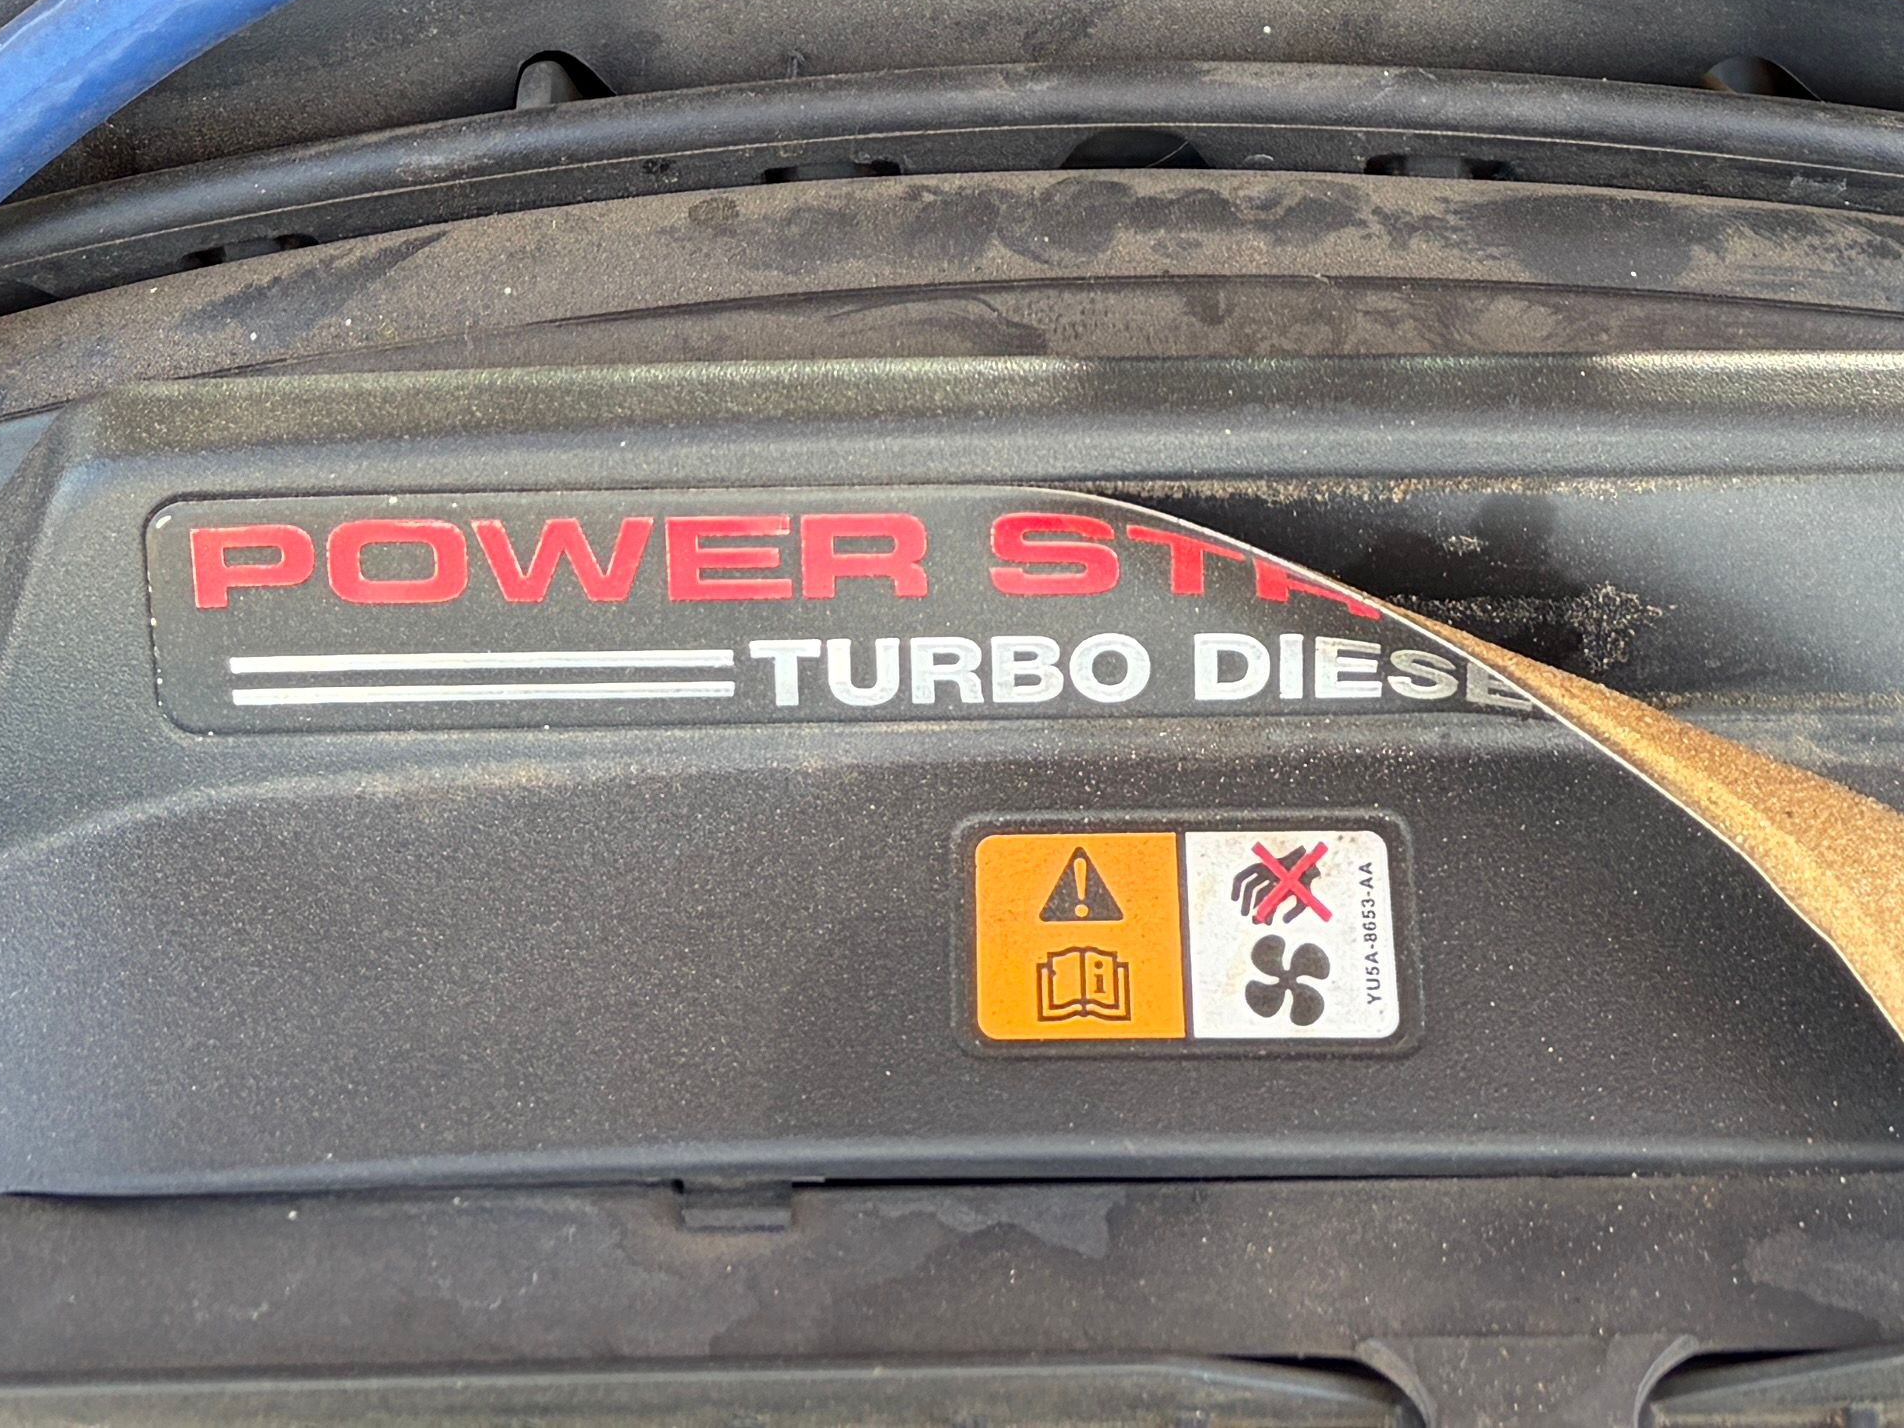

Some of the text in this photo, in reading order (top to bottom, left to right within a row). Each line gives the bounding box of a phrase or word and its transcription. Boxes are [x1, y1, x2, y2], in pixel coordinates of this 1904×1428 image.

[189, 512, 930, 610] POWER
[748, 630, 1151, 712] TURBO
[1359, 860, 1382, 1005] YU5A-8653-AA
